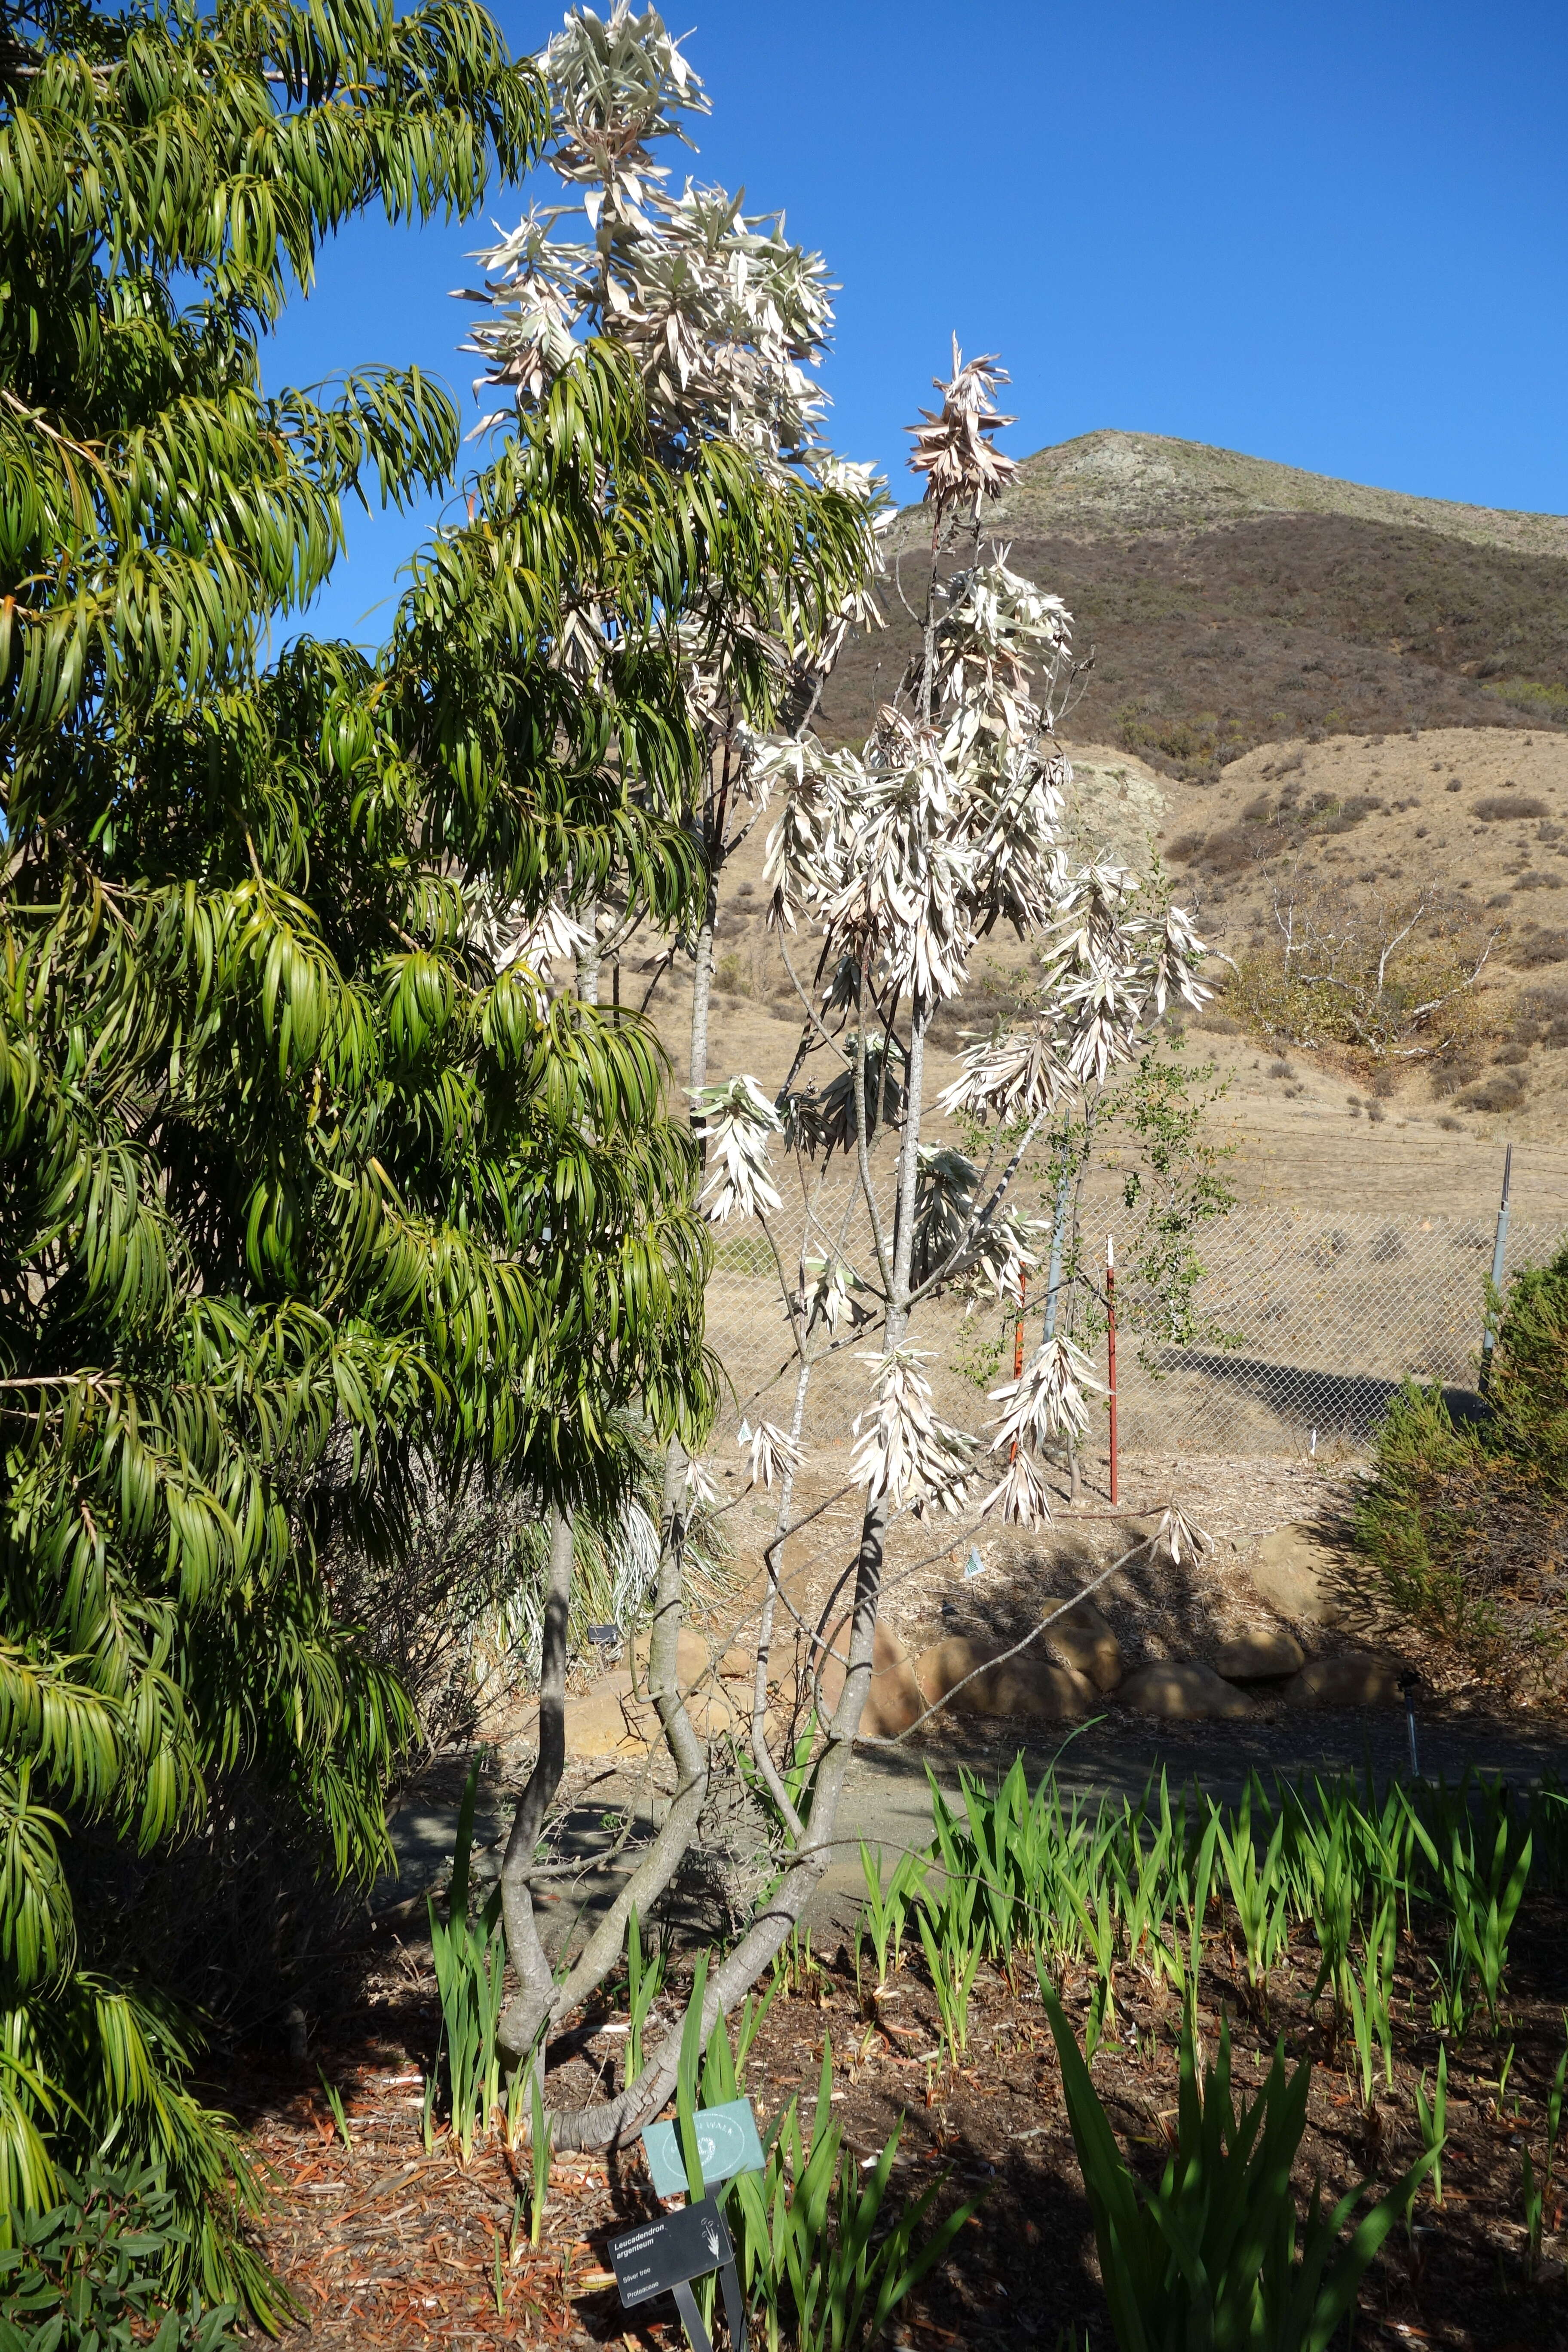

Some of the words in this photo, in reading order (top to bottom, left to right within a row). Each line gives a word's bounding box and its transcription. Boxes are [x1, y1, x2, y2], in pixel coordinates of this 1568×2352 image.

[614, 2223, 664, 2251] Leucadendron
[616, 2238, 654, 2259] argenteum
[623, 2273, 638, 2284] Silver
[639, 2267, 651, 2277] tree
[627, 2281, 659, 2299] Proteaceae
